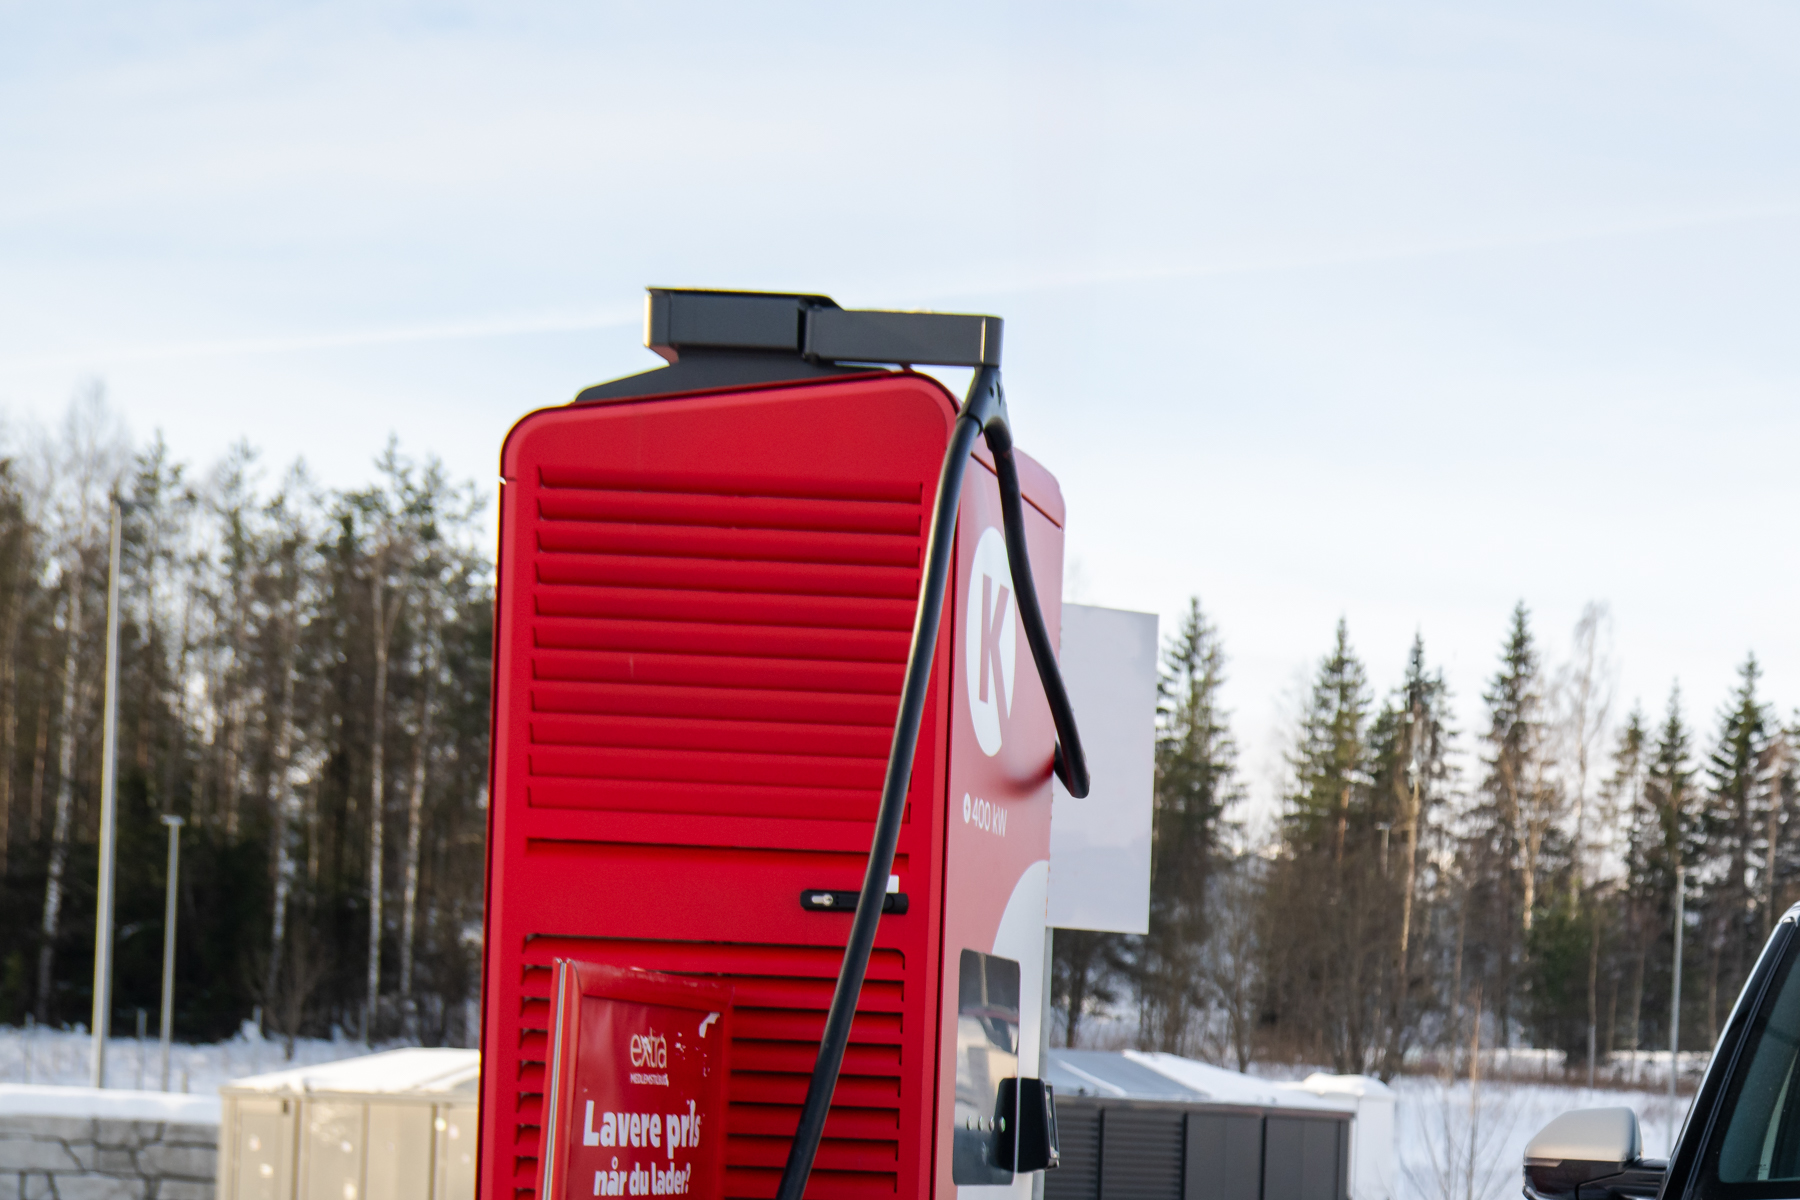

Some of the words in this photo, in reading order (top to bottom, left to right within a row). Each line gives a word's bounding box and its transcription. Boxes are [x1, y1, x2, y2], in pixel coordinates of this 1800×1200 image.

[972, 797, 991, 832] 400
[992, 807, 1008, 838] kW
[630, 1028, 668, 1069] extra
[583, 1099, 662, 1148] Lavere
[666, 1099, 701, 1160] pris
[593, 1155, 628, 1197] når
[629, 1161, 650, 1197] du
[651, 1161, 692, 1196] lader?
